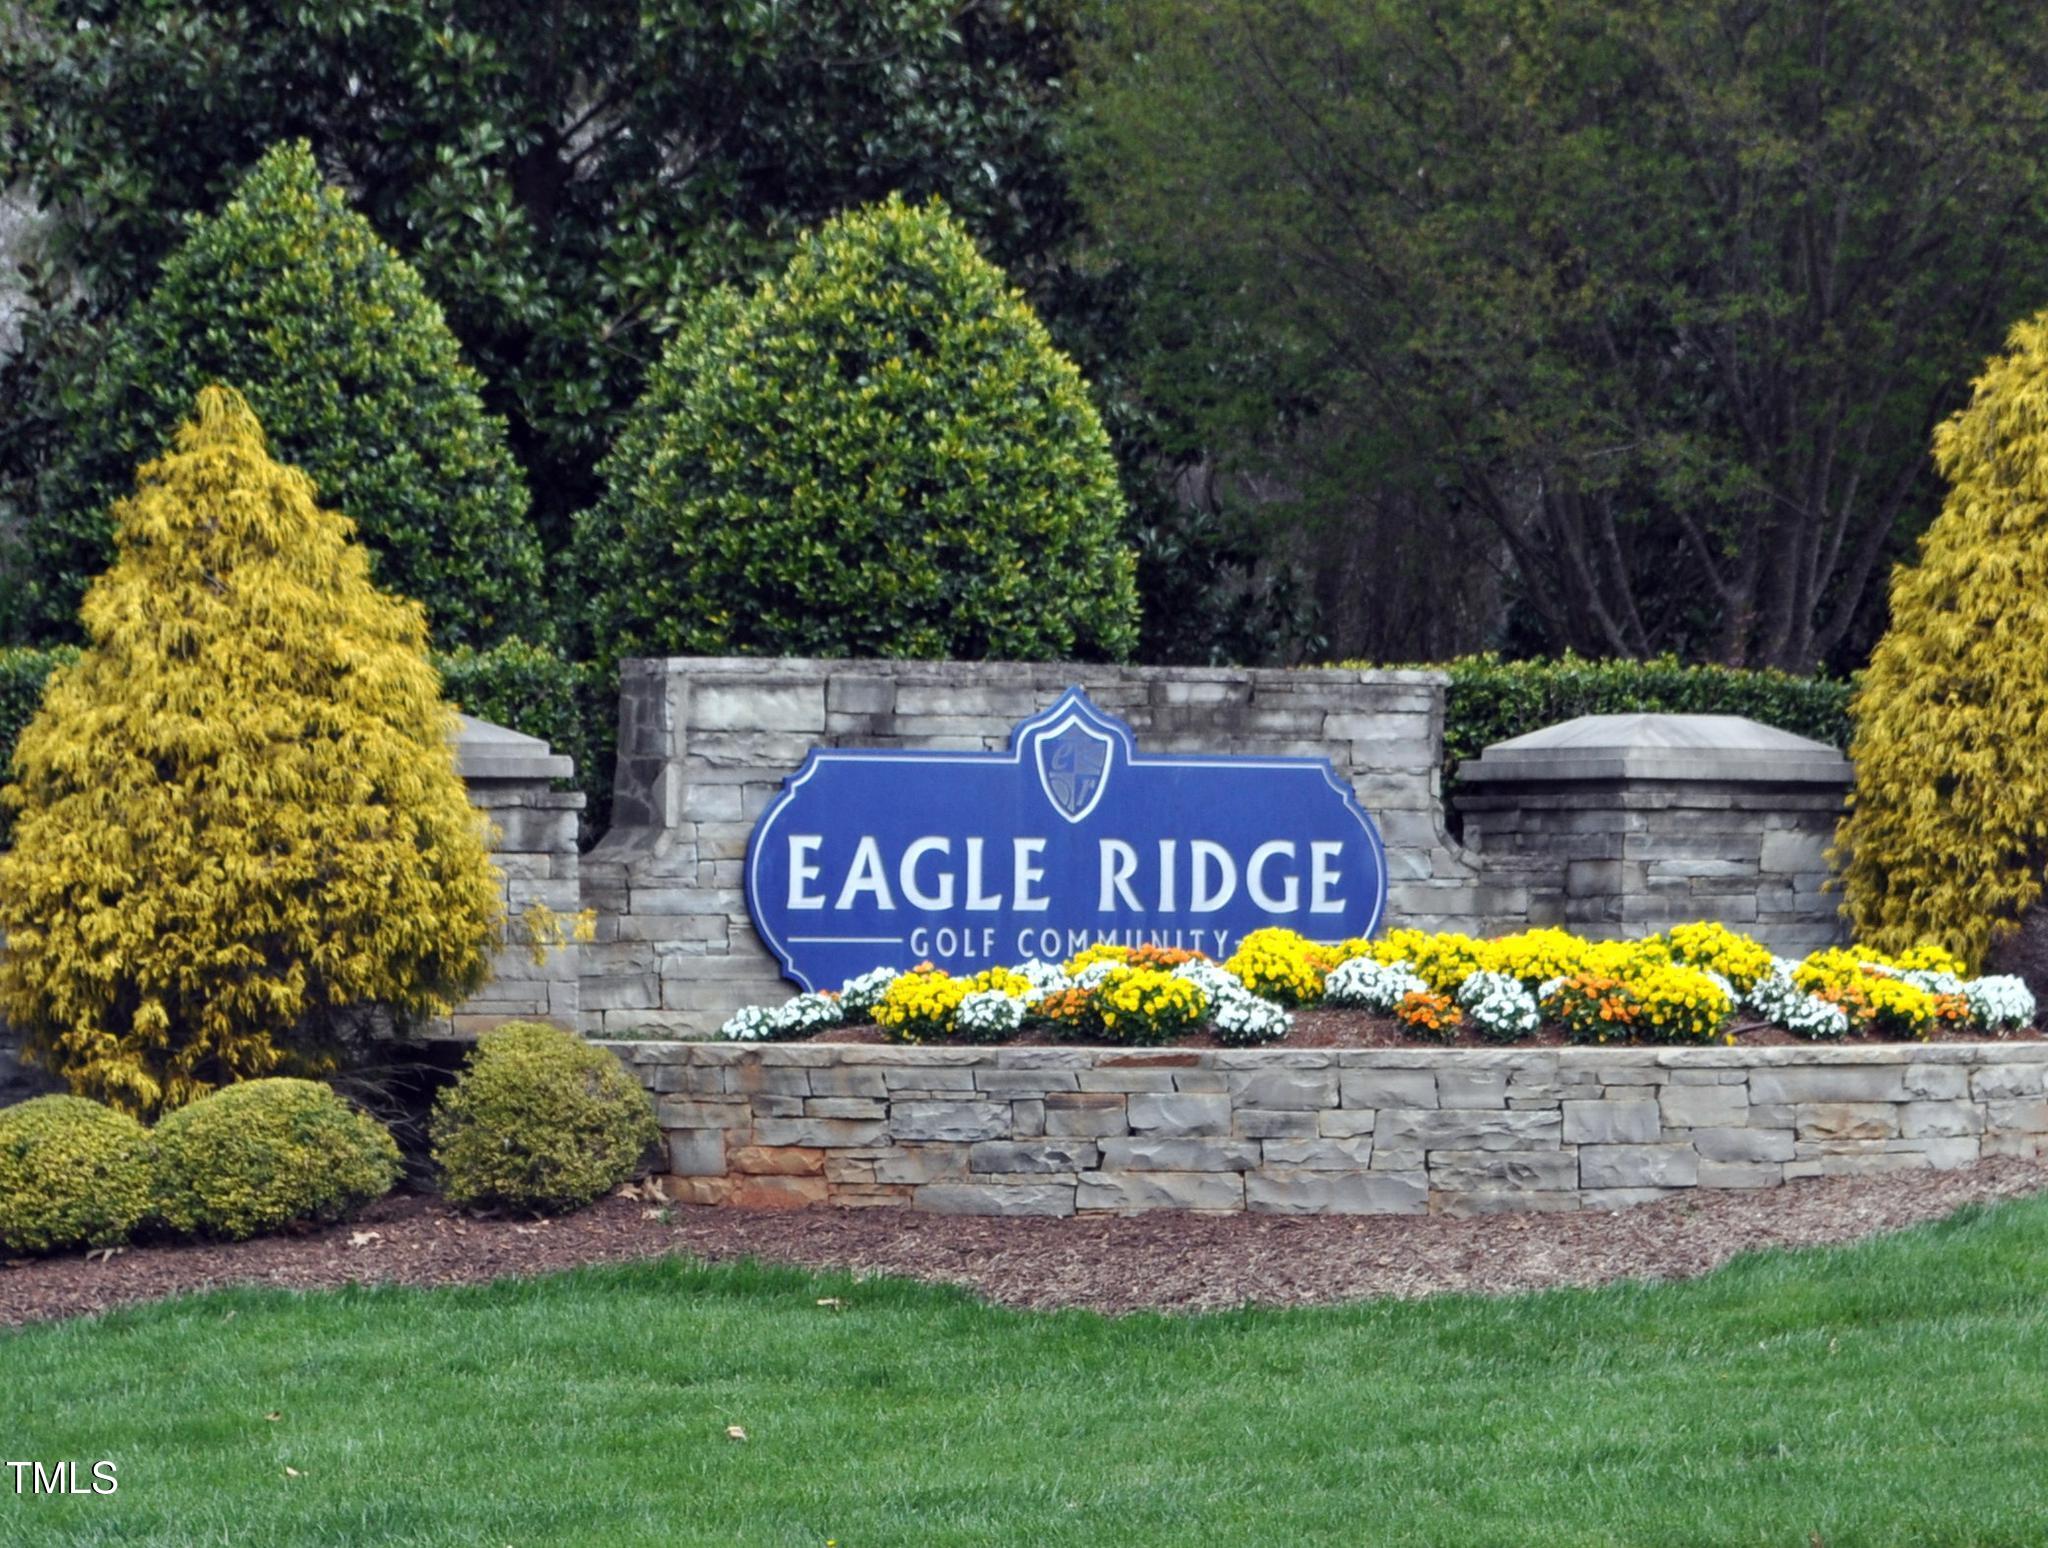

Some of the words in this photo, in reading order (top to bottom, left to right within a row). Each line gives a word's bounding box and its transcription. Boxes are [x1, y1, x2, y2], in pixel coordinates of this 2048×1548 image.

[787, 836, 1051, 911] EAGLE
[1099, 838, 1347, 914] RIDGE
[910, 926, 995, 959] GOLF
